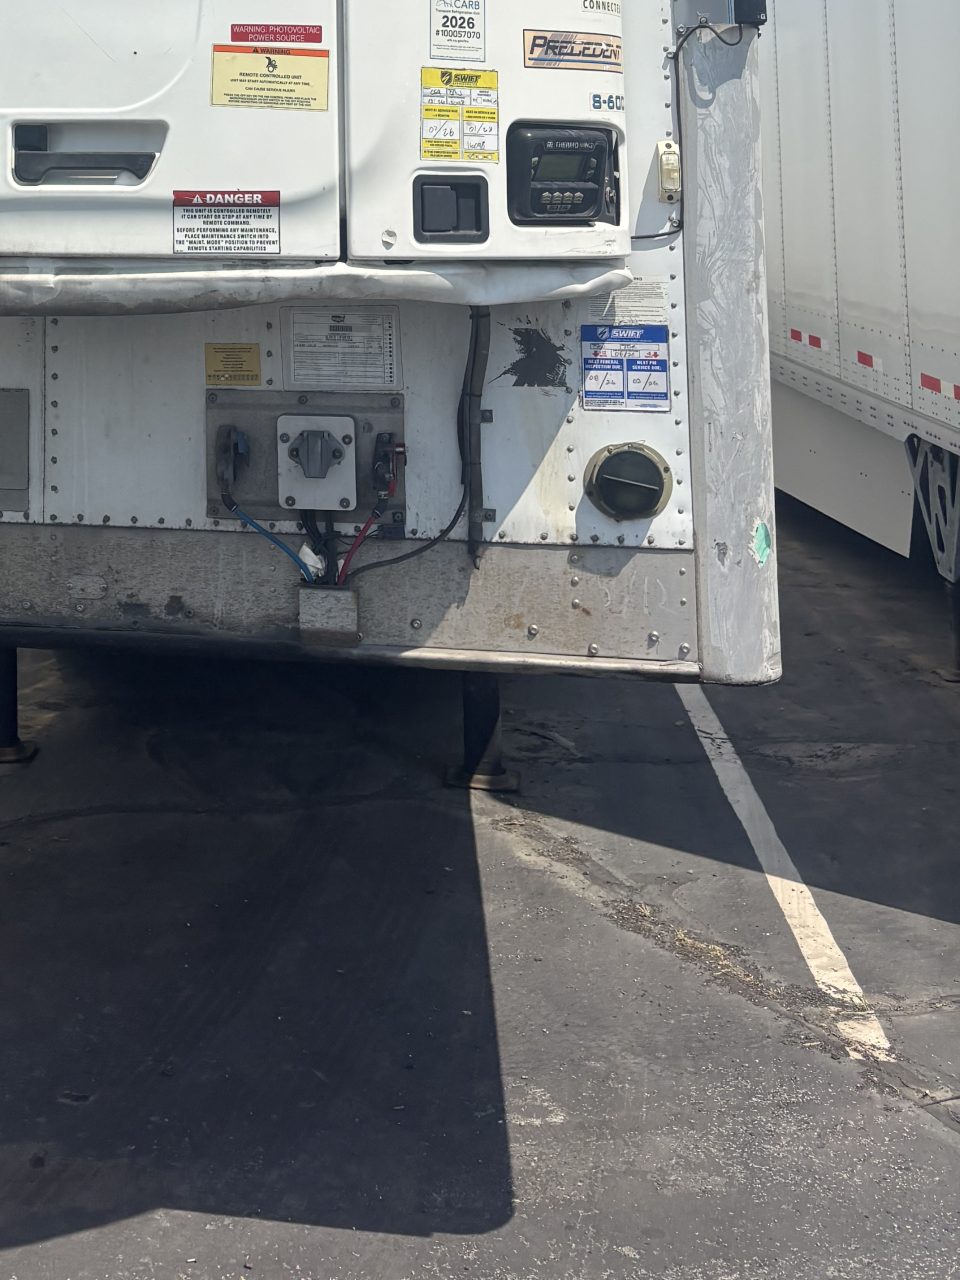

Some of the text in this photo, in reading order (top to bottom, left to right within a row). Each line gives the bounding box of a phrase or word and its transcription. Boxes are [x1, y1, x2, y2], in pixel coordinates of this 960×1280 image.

[454, 0, 480, 10] CARB
[442, 15, 475, 29] 2026
[232, 25, 320, 34] WARNING: PHOTOVOLTAIC
[435, 29, 481, 39] #100057070
[276, 34, 305, 42] SOURCE
[453, 74, 481, 82] SWIFT
[206, 194, 262, 204] DANGER
[612, 329, 641, 338] SWIFT
